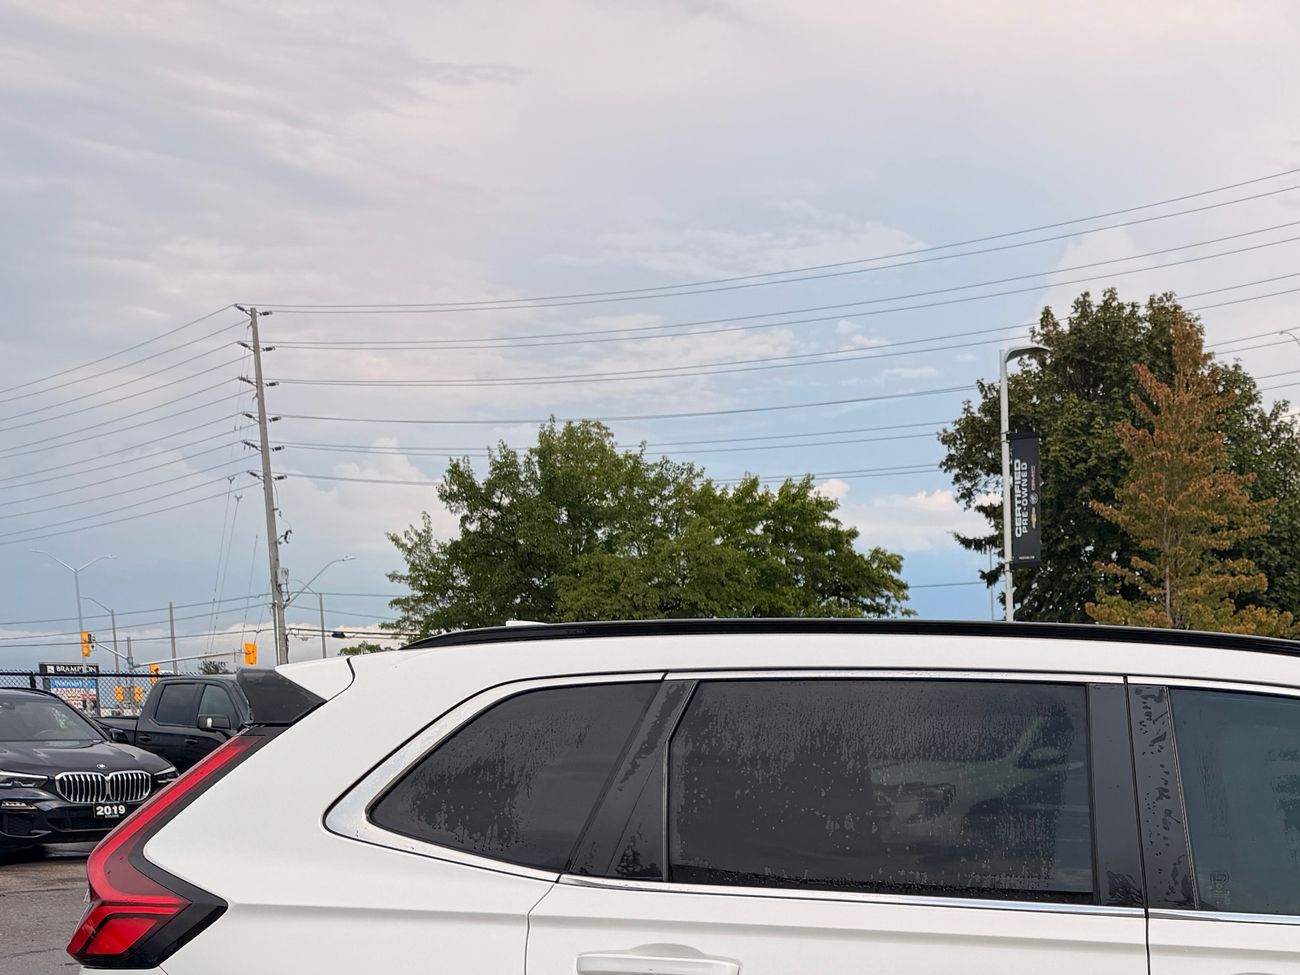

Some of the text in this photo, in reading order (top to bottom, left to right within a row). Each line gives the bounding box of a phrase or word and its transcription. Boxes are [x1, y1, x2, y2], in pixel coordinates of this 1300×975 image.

[1013, 459, 1022, 538] CERTIFIED
[1021, 462, 1029, 534] PRE-OWNED
[96, 804, 126, 816] 2019
